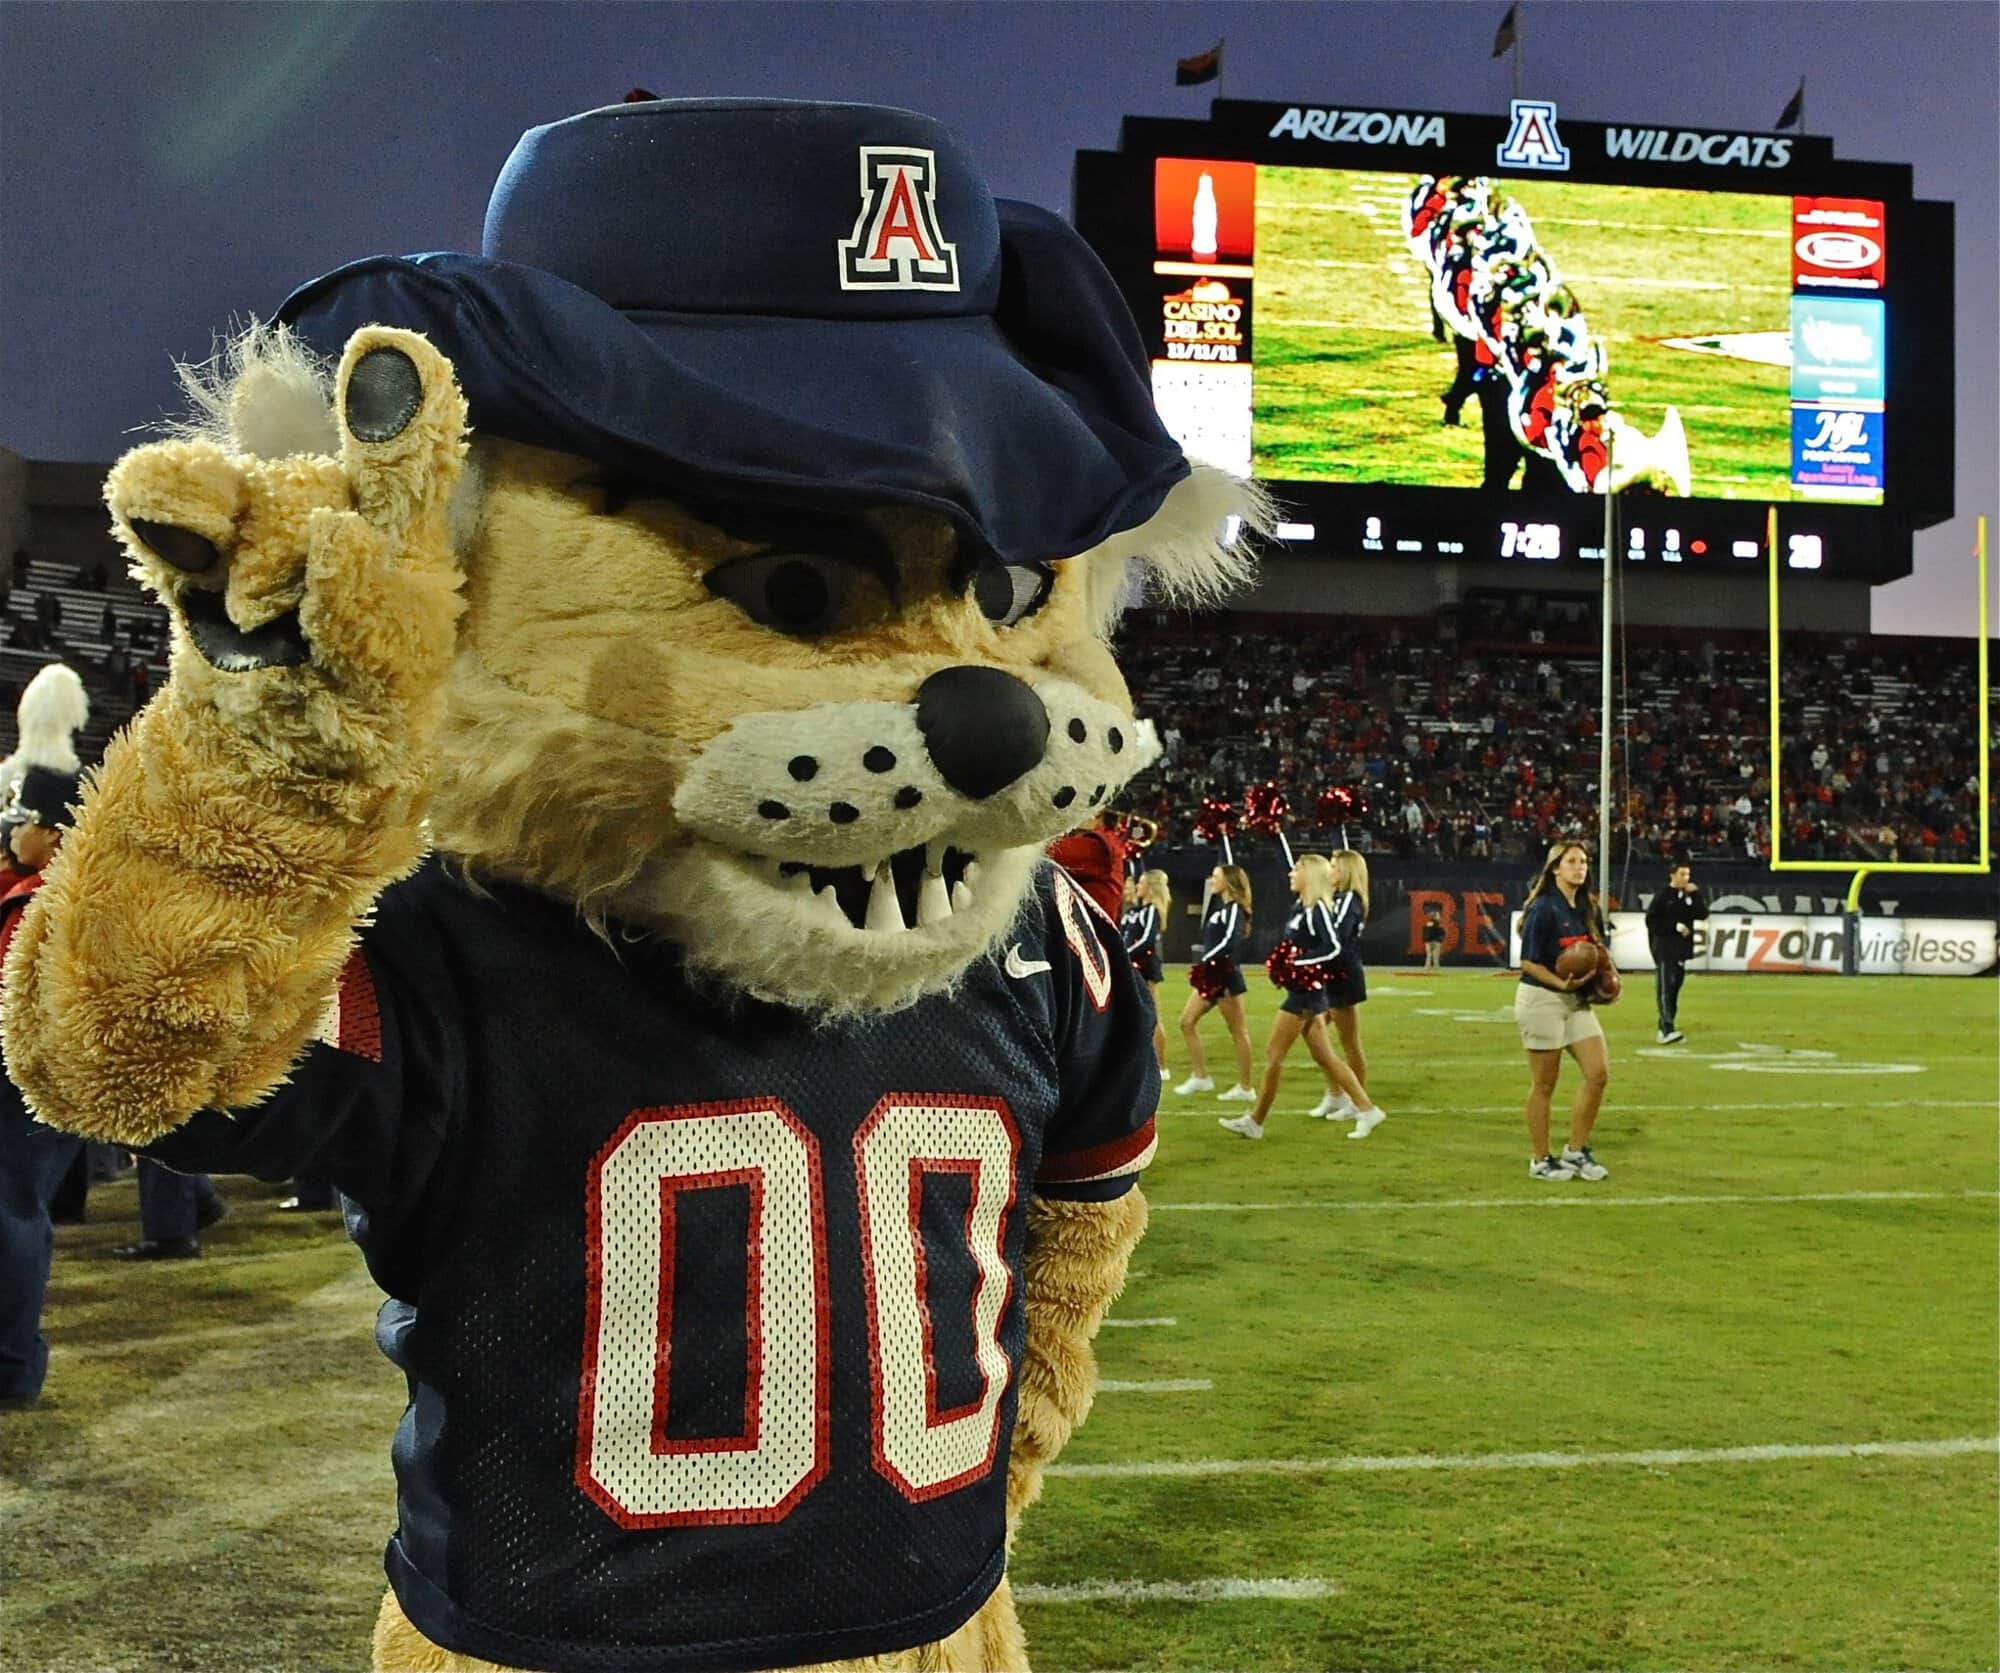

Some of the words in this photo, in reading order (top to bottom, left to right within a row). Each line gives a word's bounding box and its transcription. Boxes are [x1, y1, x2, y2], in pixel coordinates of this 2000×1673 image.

[1268, 108, 1446, 147] ARIZONA
[1497, 99, 1570, 171] A
[1606, 128, 1793, 168] WILDCATS
[838, 146, 960, 292] A
[1163, 301, 1241, 322] CASINO
[1164, 319, 1203, 340] DEL
[1203, 321, 1242, 341] SOL
[1692, 917, 1844, 972] erizon
[575, 1092, 1023, 1531] 00
